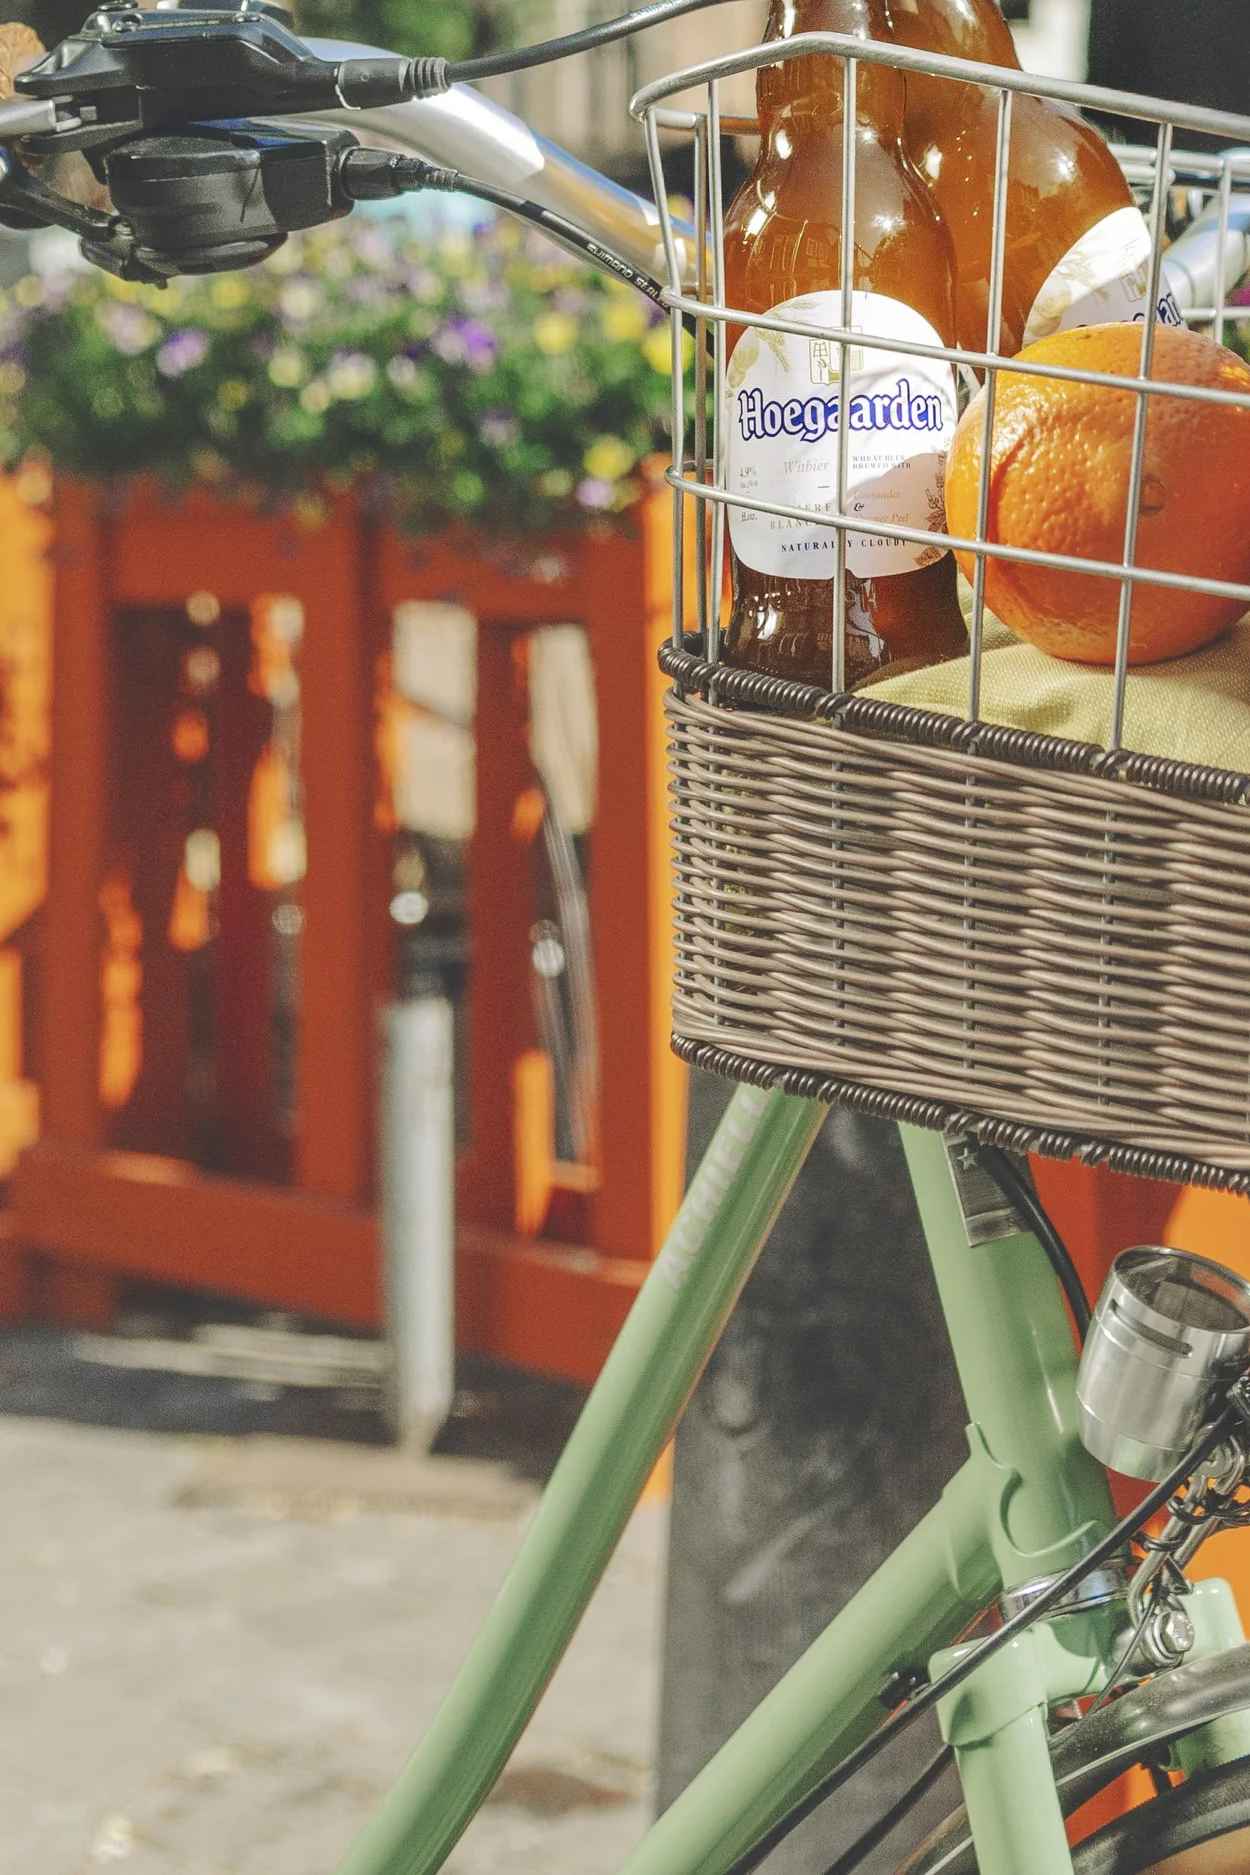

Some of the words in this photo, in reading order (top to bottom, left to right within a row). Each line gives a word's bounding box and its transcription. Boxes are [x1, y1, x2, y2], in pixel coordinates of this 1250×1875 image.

[738, 377, 944, 444] Hoegaarden
[851, 454, 883, 462] WHEAT
[783, 460, 830, 474] Witbier
[851, 462, 889, 470] BREWED
[853, 502, 865, 512] &
[769, 519, 819, 530] BLANC
[781, 540, 854, 553] NATURALY
